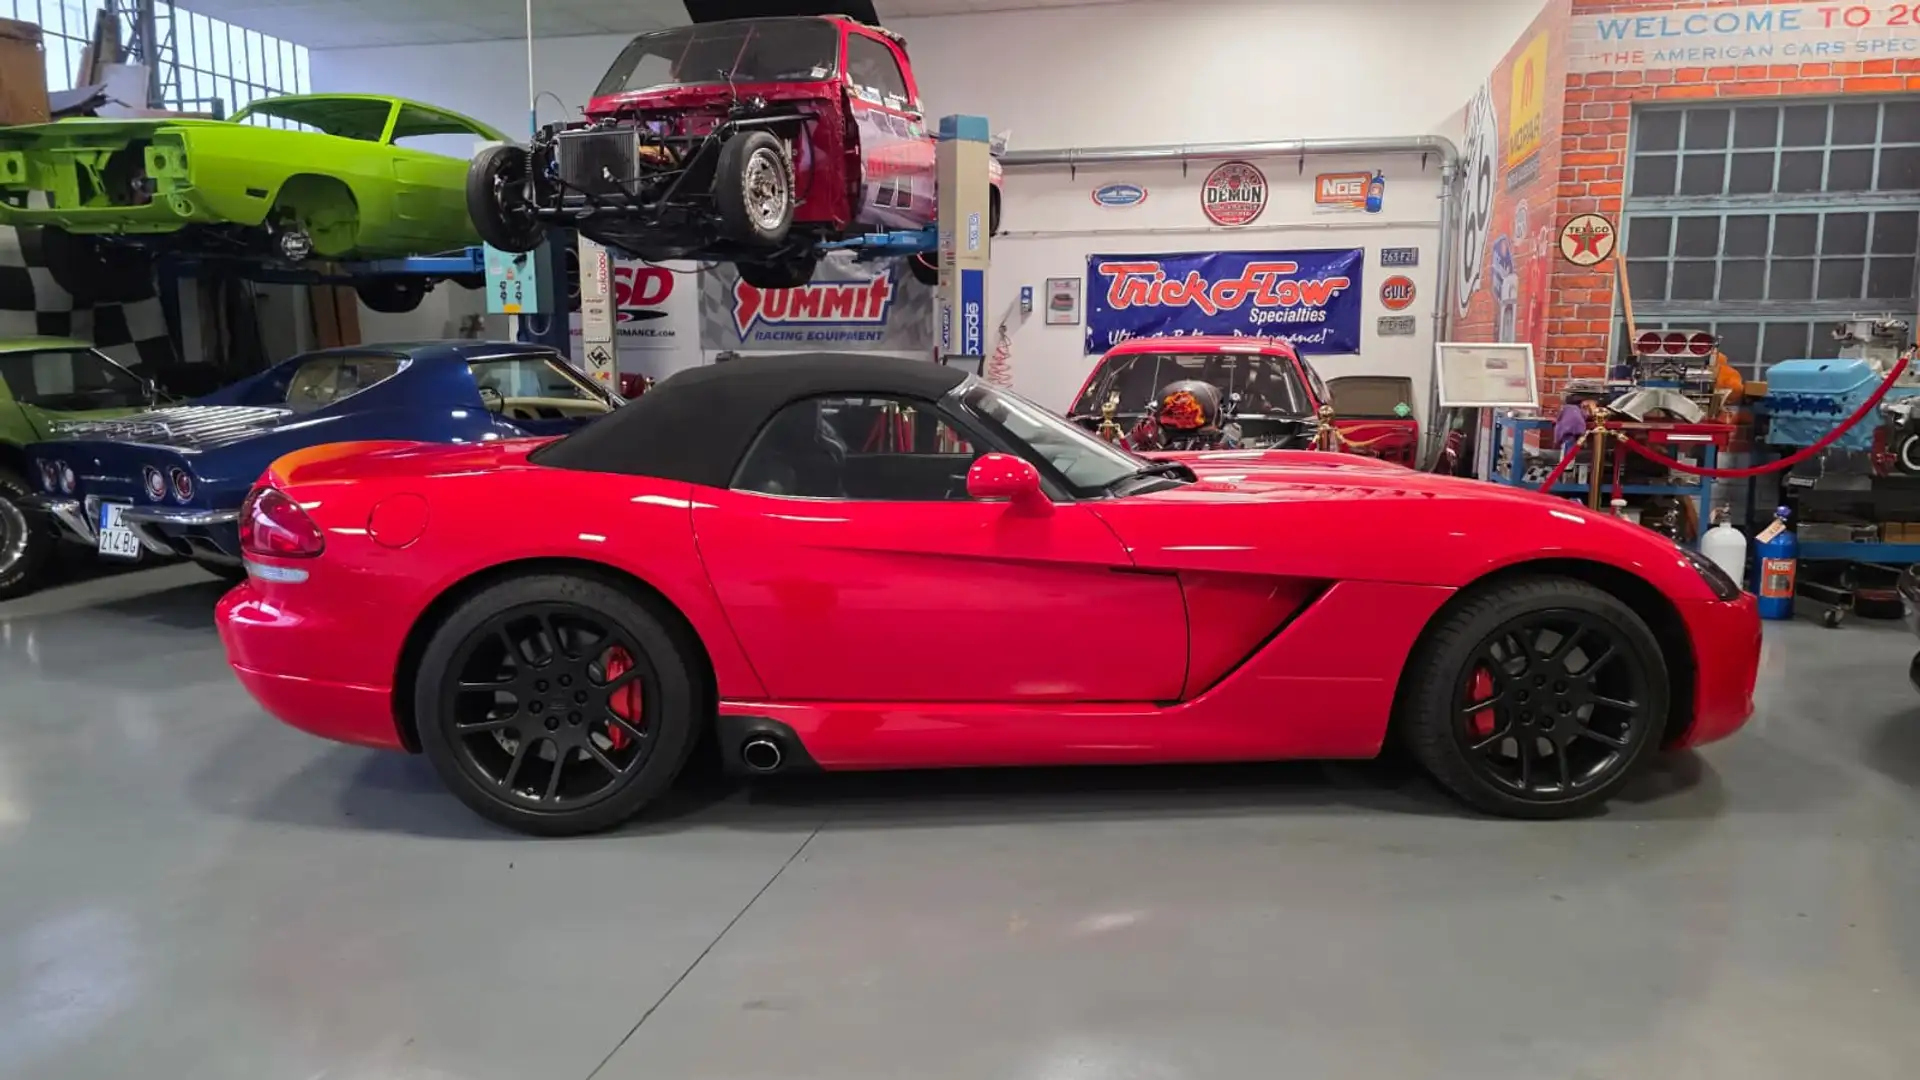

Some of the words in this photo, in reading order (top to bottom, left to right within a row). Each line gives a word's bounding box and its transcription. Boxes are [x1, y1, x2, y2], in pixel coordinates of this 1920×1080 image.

[1596, 9, 1803, 41] WELCOME
[1818, 6, 1872, 29] TO
[1653, 45, 1774, 62] AMERICAN
[1783, 41, 1846, 57] CARS
[1509, 111, 1540, 156] MOPAR
[1207, 187, 1262, 203] DEMON
[613, 266, 675, 307] SD
[1099, 262, 1216, 315] Trick
[1211, 262, 1350, 309] Flow
[1383, 285, 1413, 299] GULF
[1249, 308, 1326, 325] Specialties
[755, 331, 803, 341] RACING
[806, 331, 884, 341] EQUIPMENT
[964, 302, 980, 355] sparc
[101, 531, 119, 550] 214
